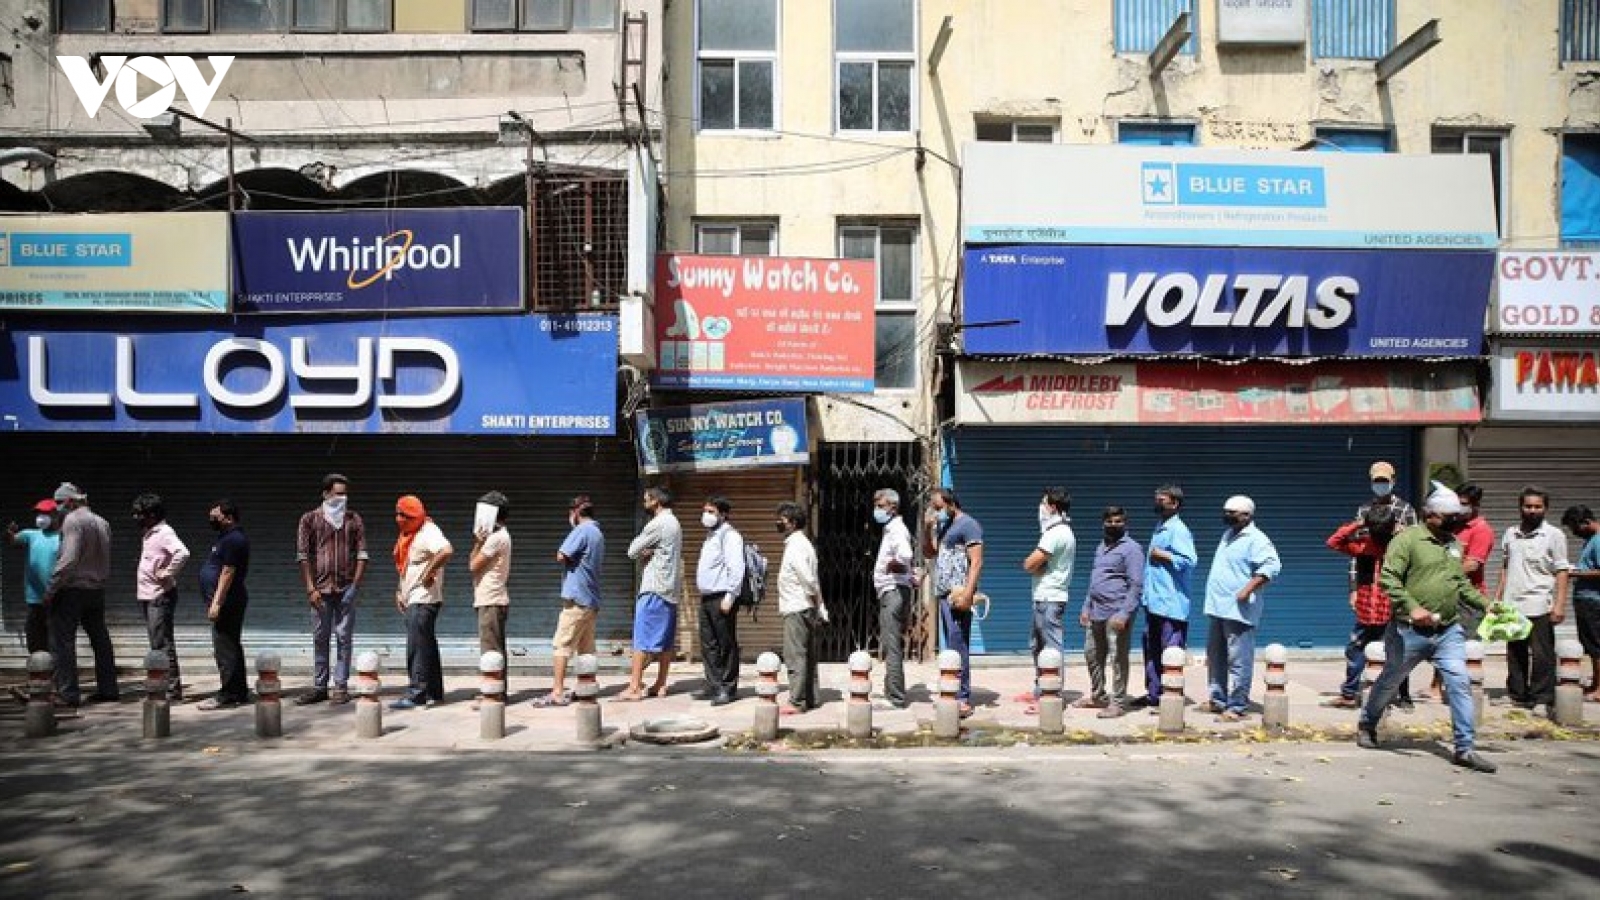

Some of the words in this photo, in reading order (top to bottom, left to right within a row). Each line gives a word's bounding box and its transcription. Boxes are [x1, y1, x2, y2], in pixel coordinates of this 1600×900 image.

[1189, 176, 1246, 193] BLUE
[1257, 178, 1313, 195] STAR
[1364, 234, 1412, 245] UNITED
[1415, 234, 1483, 246] AGENCIES
[20, 243, 68, 257] BLUE
[74, 243, 122, 257] STAR
[286, 234, 461, 281] Whirlpool
[989, 254, 1016, 264] TATA
[1021, 254, 1065, 266] Enterprise
[1501, 256, 1600, 281] GOVT.
[668, 256, 735, 297] Sunny
[742, 258, 819, 293] Watch
[824, 262, 860, 294] Co.
[275, 292, 343, 303] ENTERPRISES
[1104, 271, 1361, 330] VOLTAS
[1502, 305, 1579, 326] GOLD
[1370, 338, 1410, 348] UNITED
[1412, 338, 1468, 349] AGENCIES
[28, 335, 461, 408] LLOYD
[1515, 350, 1600, 387] PAWA
[1030, 375, 1122, 391] MIDDLEBY
[1026, 394, 1120, 410] CELFROST
[481, 415, 526, 429] SHAKTI
[528, 415, 611, 429] ENTERPRISES
[666, 416, 711, 433] SUNNY
[714, 411, 763, 431] WATCH
